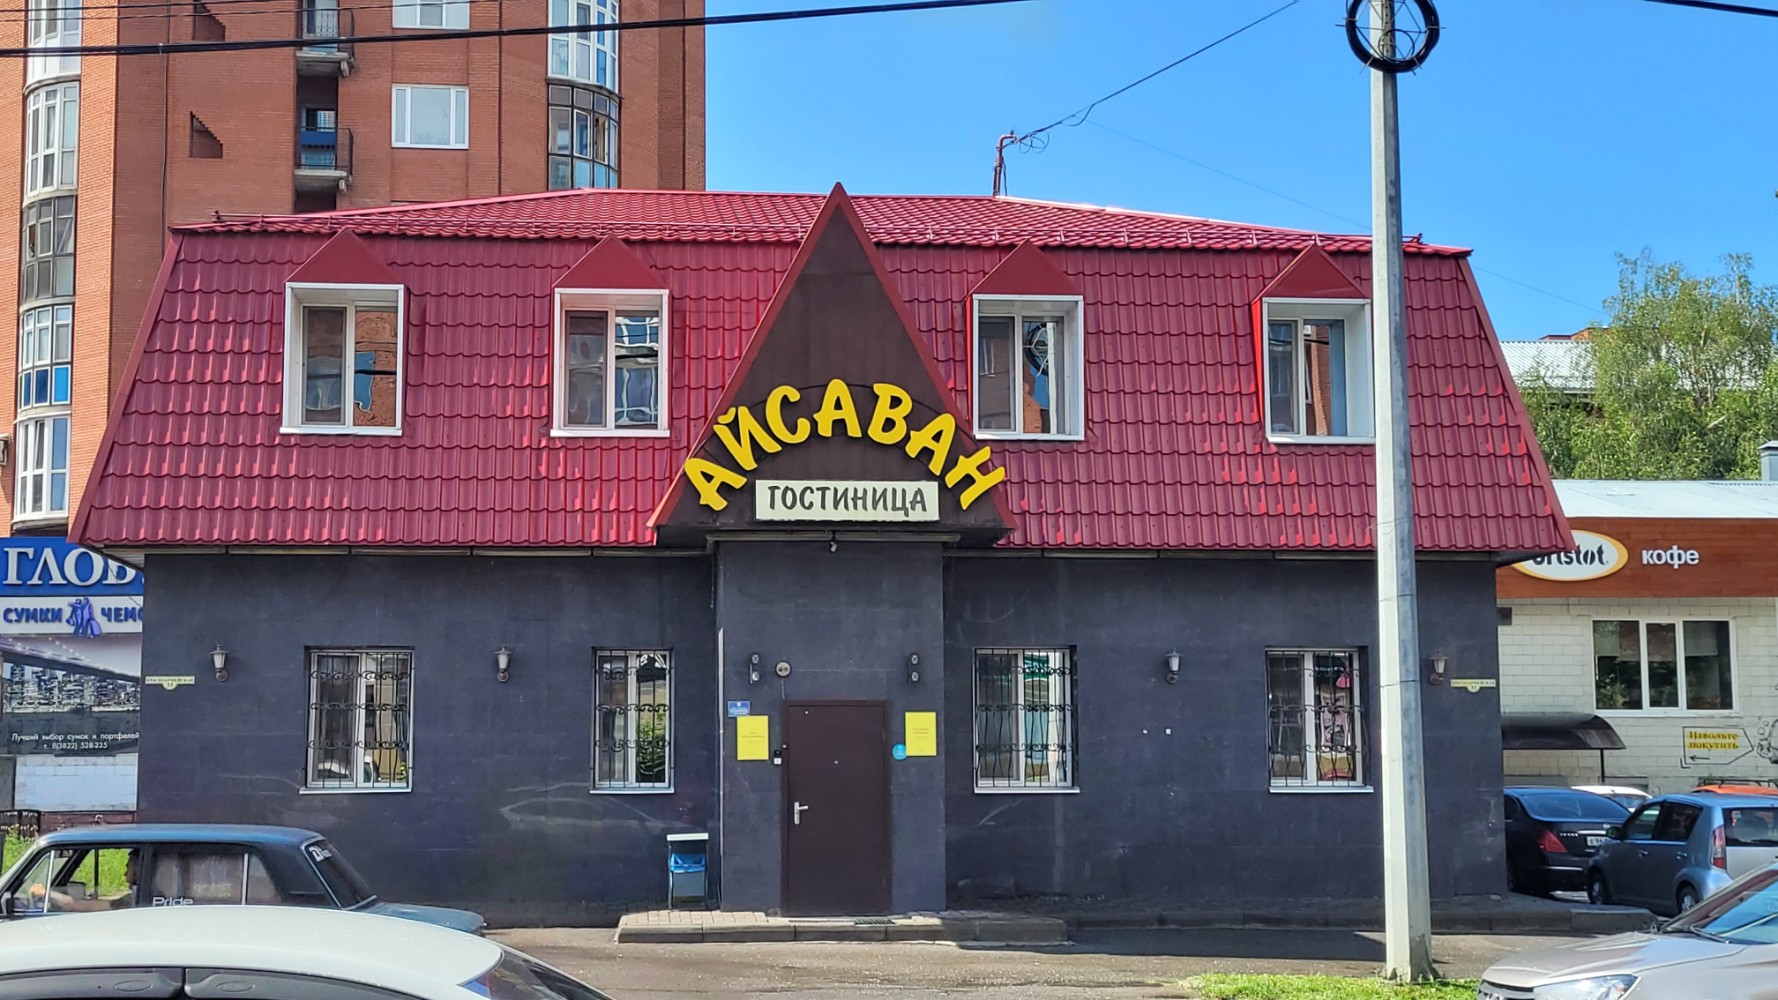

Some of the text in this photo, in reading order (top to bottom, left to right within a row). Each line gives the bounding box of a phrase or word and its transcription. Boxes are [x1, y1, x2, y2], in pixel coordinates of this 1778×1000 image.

[684, 378, 1006, 511] АЙСАВАН
[768, 485, 927, 517] ГОСТИНИЦА
[3, 547, 143, 586] ГЛОБ
[1641, 545, 1700, 569] кофе
[3, 607, 63, 624] СУМКИ
[12, 733, 39, 742] Лучший
[42, 733, 64, 742] выбор
[100, 732, 140, 741] портфелей
[152, 896, 194, 907] Pride
